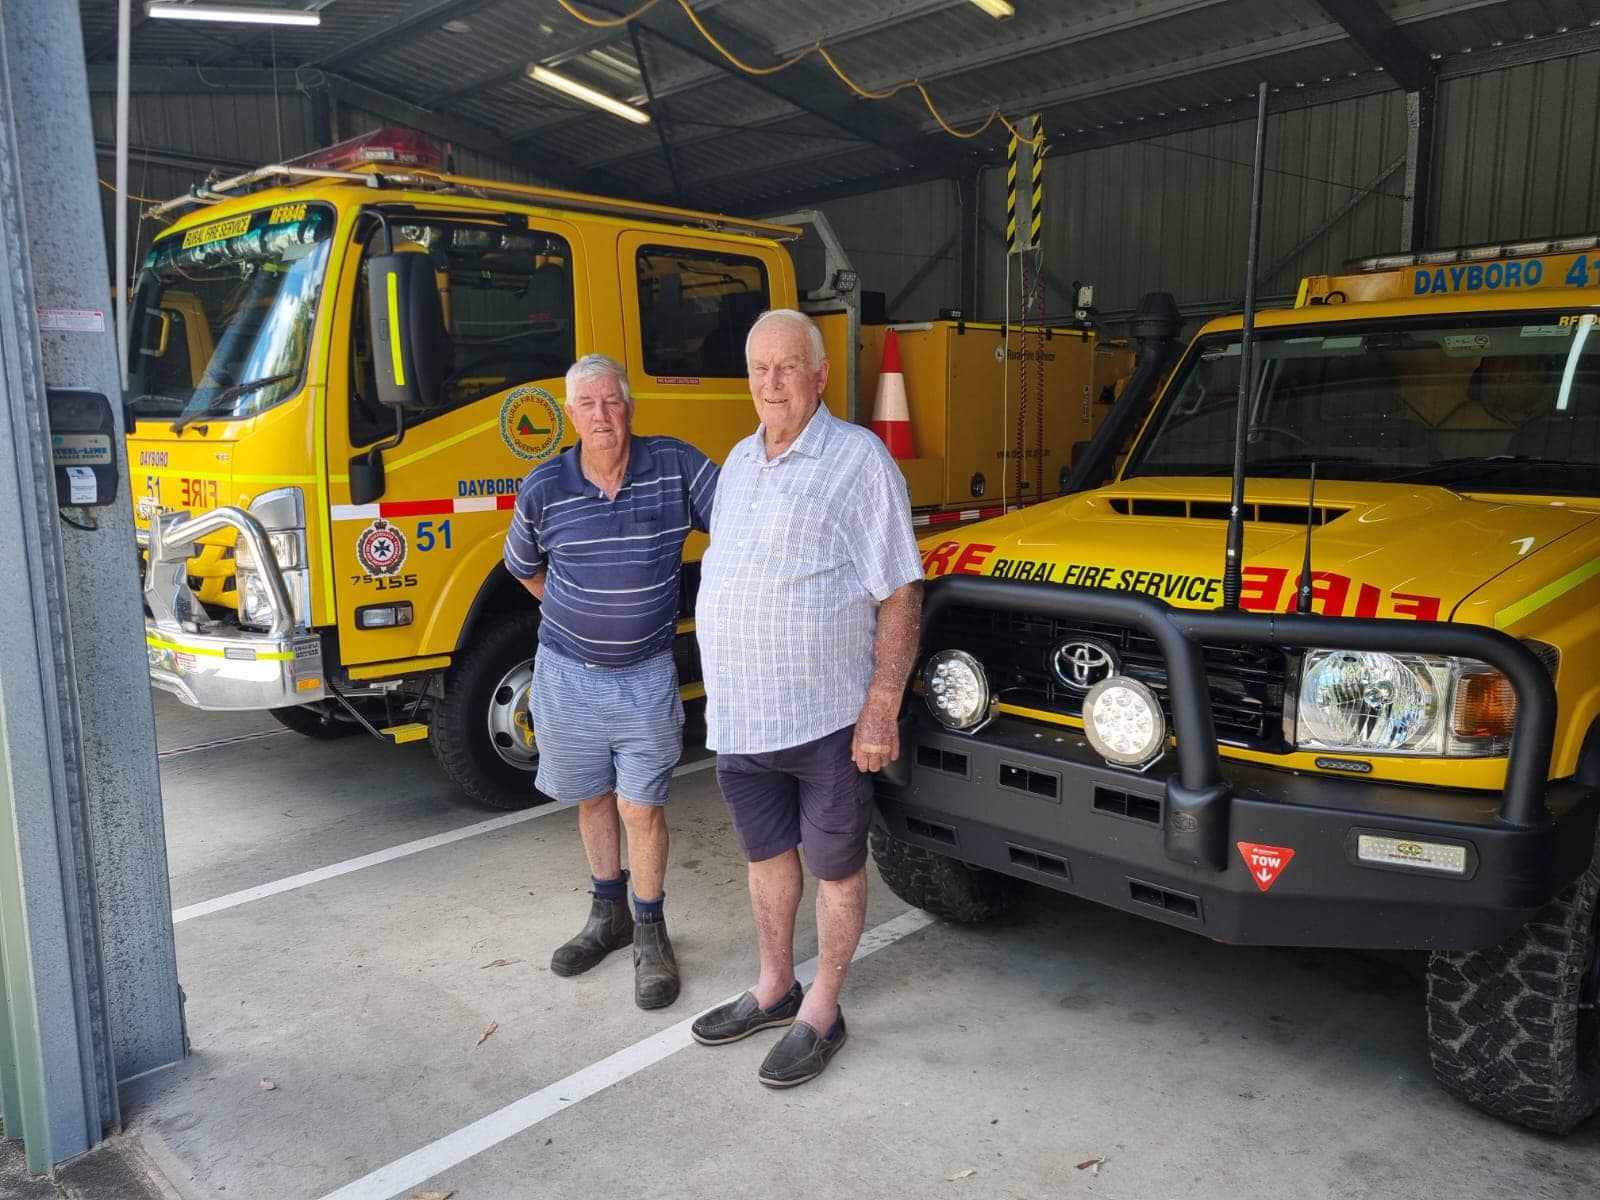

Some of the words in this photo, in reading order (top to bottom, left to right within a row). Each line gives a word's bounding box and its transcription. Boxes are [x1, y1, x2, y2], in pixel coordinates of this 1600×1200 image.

[185, 231, 203, 246] RURAL
[204, 225, 219, 240] FIRE
[220, 216, 248, 236] SERVICE
[1414, 259, 1543, 295] DAYBORO
[508, 402, 521, 424] RURAL
[536, 396, 556, 422] SERVICE
[140, 451, 168, 467] DAYBORO
[515, 437, 553, 453] QUEENSLAND
[147, 476, 160, 504] 51
[416, 520, 452, 552] 51
[919, 541, 997, 575] RE
[376, 574, 418, 591] 155
[991, 558, 1056, 582] RURAL
[1063, 564, 1115, 589] FIRE
[1116, 569, 1222, 603] SERVICE
[1251, 854, 1281, 869] TOW
